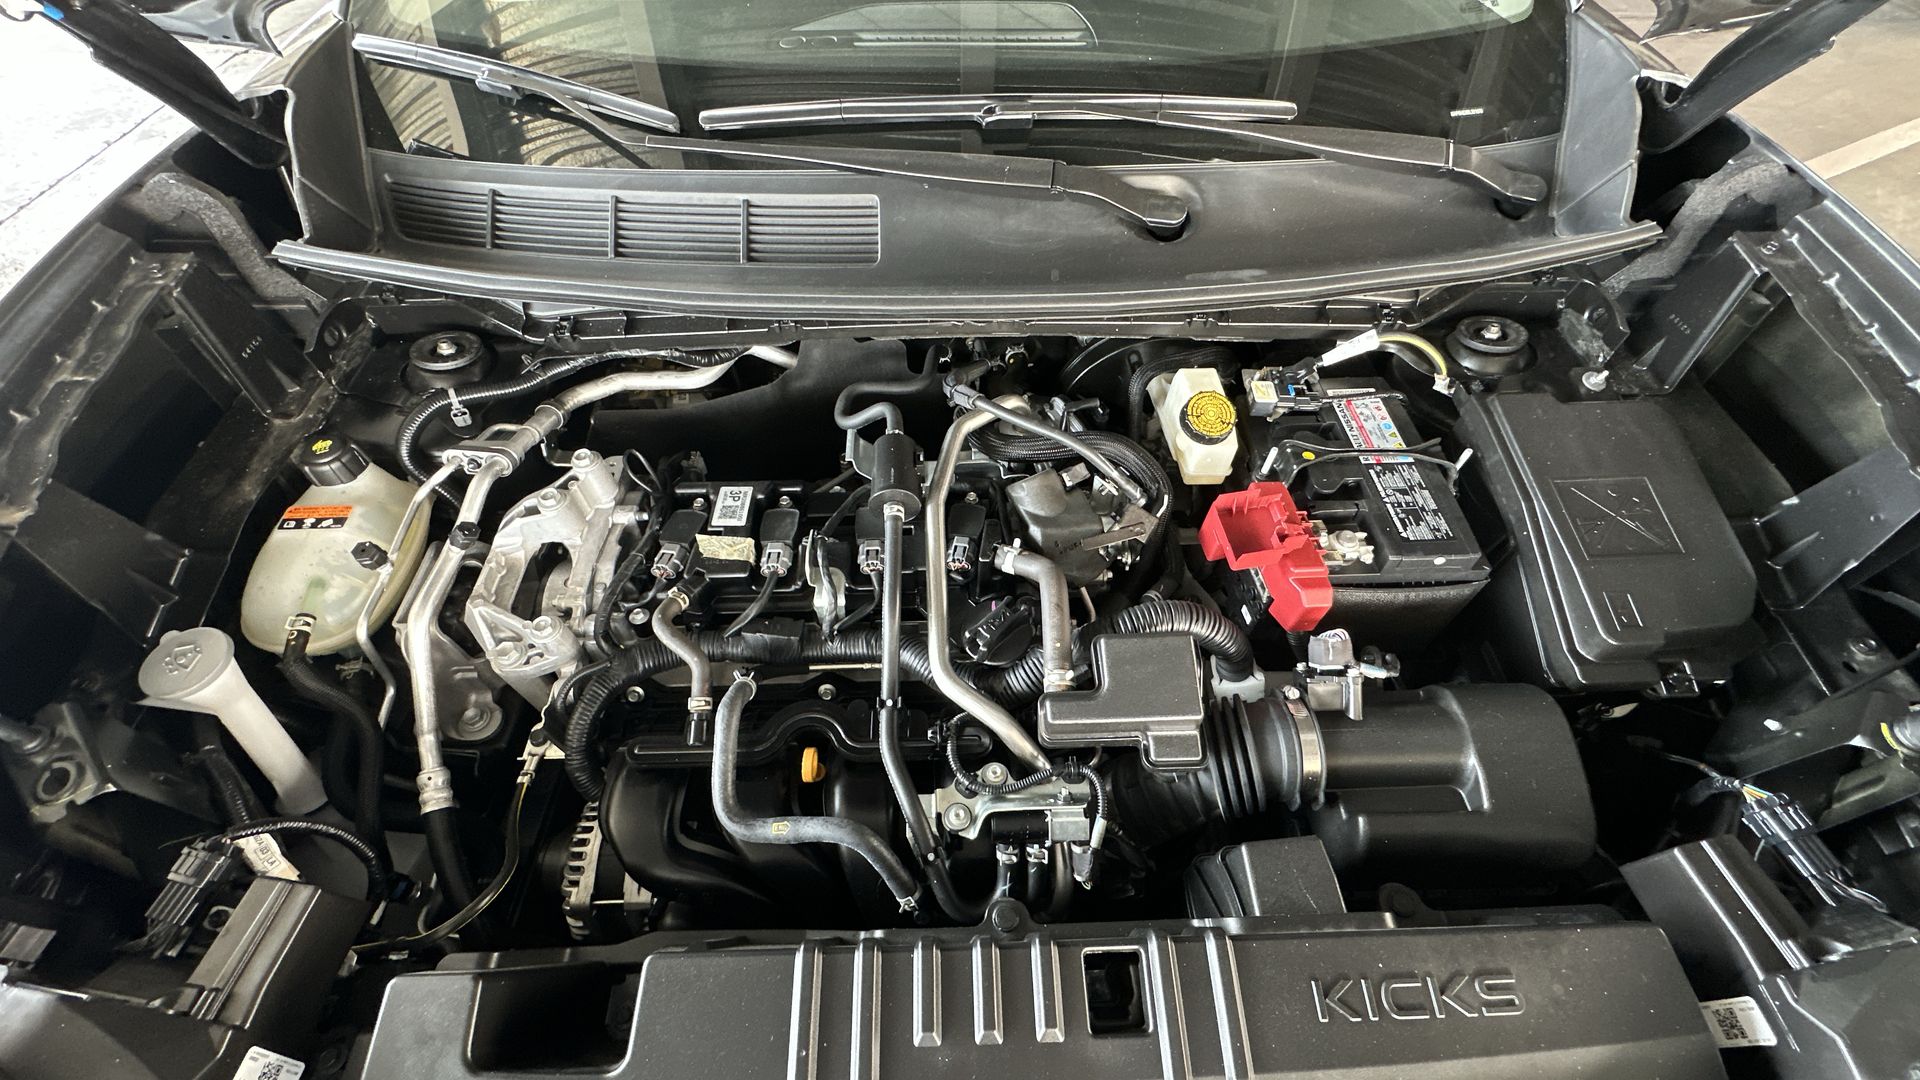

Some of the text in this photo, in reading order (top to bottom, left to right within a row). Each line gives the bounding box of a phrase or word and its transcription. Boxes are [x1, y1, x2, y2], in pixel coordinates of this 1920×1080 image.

[1336, 403, 1355, 432] NISSAN
[1351, 433, 1371, 462] RAULT
[729, 490, 742, 502] 3P
[1311, 974, 1526, 1022] KICKS
